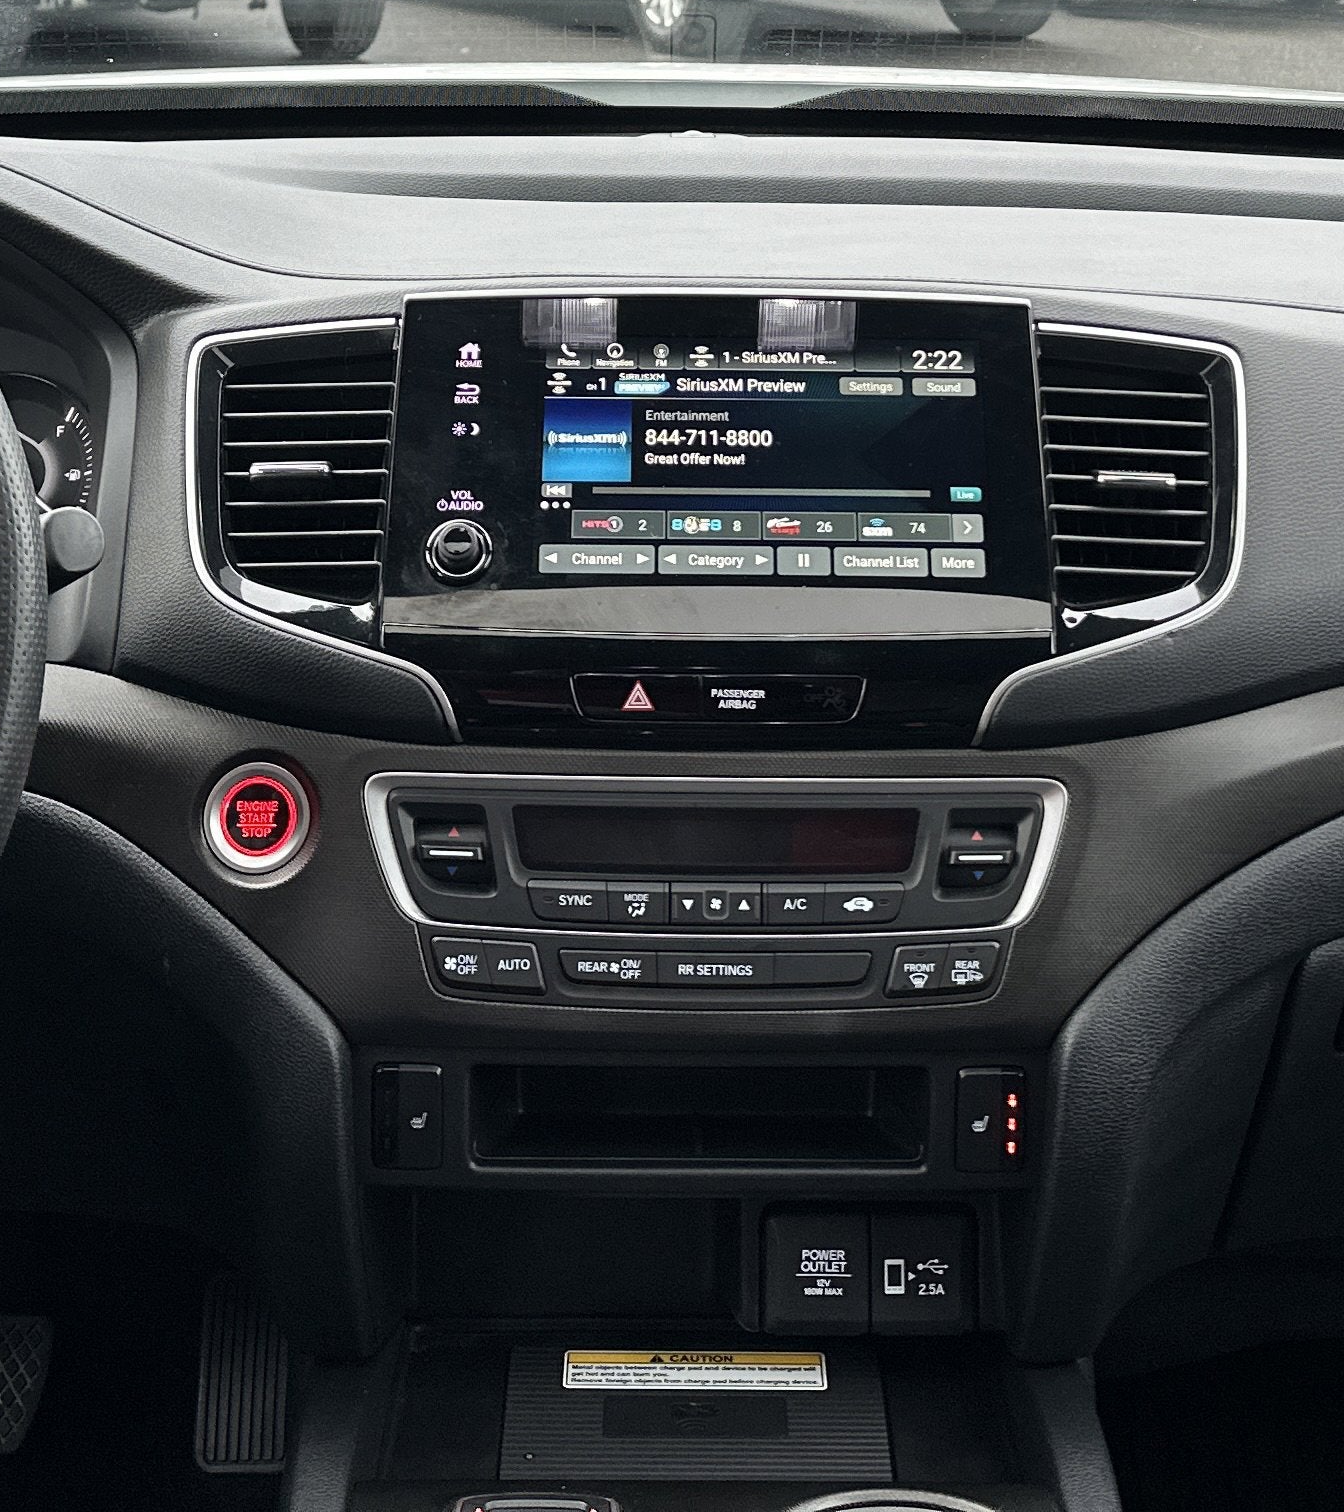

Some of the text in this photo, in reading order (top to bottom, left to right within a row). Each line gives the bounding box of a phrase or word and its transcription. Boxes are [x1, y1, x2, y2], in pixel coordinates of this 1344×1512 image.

[456, 360, 483, 368] HOME
[557, 358, 581, 367] Phone
[596, 359, 634, 368] Navigation
[655, 359, 668, 368] FM
[741, 351, 800, 365] SiriusXM
[911, 350, 964, 370] 2:22
[599, 378, 606, 391] 1
[676, 377, 806, 393] SiriusXM Preview
[849, 381, 894, 393] Settings
[926, 382, 961, 392] Sound
[454, 395, 480, 404] BACK
[645, 410, 729, 422] Entertainment
[56, 426, 65, 438] F
[645, 429, 773, 447] 844-711-8800
[644, 453, 745, 465] Great Offer Now!
[450, 491, 474, 501] VOL
[956, 491, 974, 500] Live
[449, 502, 484, 511] AUDIO
[816, 521, 833, 533] 26
[909, 522, 927, 534] 74
[571, 552, 623, 567] Channel
[688, 553, 745, 570] Category
[843, 554, 920, 568] Channel List
[941, 556, 976, 570] More
[710, 688, 766, 699] PASSENGER
[718, 699, 757, 710] AIRBAG
[236, 800, 279, 812] ENGINE
[239, 812, 275, 823] START
[241, 827, 272, 838] STOP
[558, 894, 593, 906] SYNC
[624, 893, 649, 902] MODE
[783, 898, 807, 910] A/C
[457, 955, 478, 965] ON/
[497, 959, 531, 971] AUTO
[620, 959, 642, 969] ON/
[955, 960, 980, 970] REAR
[457, 965, 478, 975] OFF
[577, 961, 608, 973] REAR
[678, 964, 753, 977] RR SETTINGS
[903, 963, 936, 973] FRONT
[620, 969, 642, 979] OFF
[801, 1249, 846, 1261] POWER
[800, 1261, 848, 1273] OUTLET
[816, 1278, 831, 1287] 12V
[824, 1288, 843, 1296] MAX
[918, 1283, 946, 1296] 2.5A
[669, 1354, 734, 1363] CAUTION
